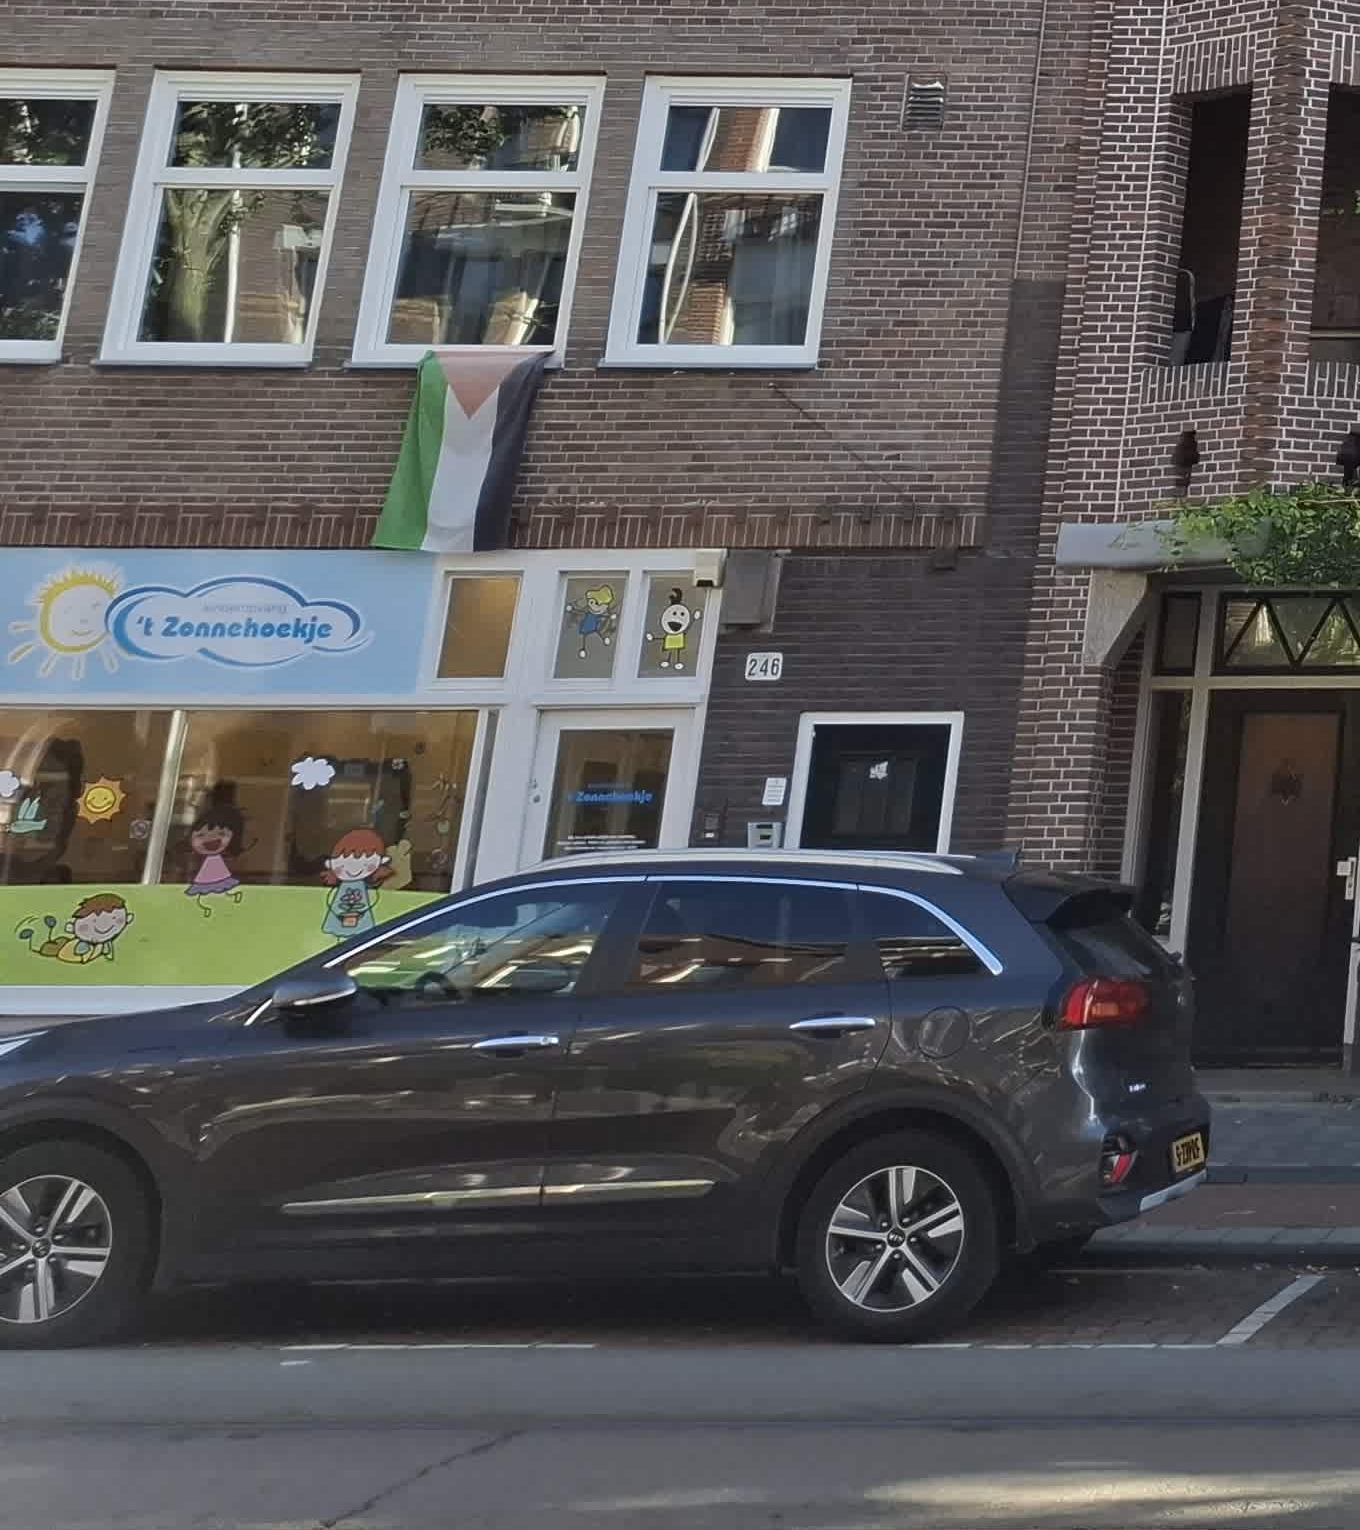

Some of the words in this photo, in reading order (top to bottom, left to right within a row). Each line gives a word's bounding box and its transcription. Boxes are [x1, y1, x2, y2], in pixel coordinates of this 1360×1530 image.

[136, 616, 153, 637] 't
[161, 615, 333, 645] Zonnehoekje
[748, 657, 780, 676] 246
